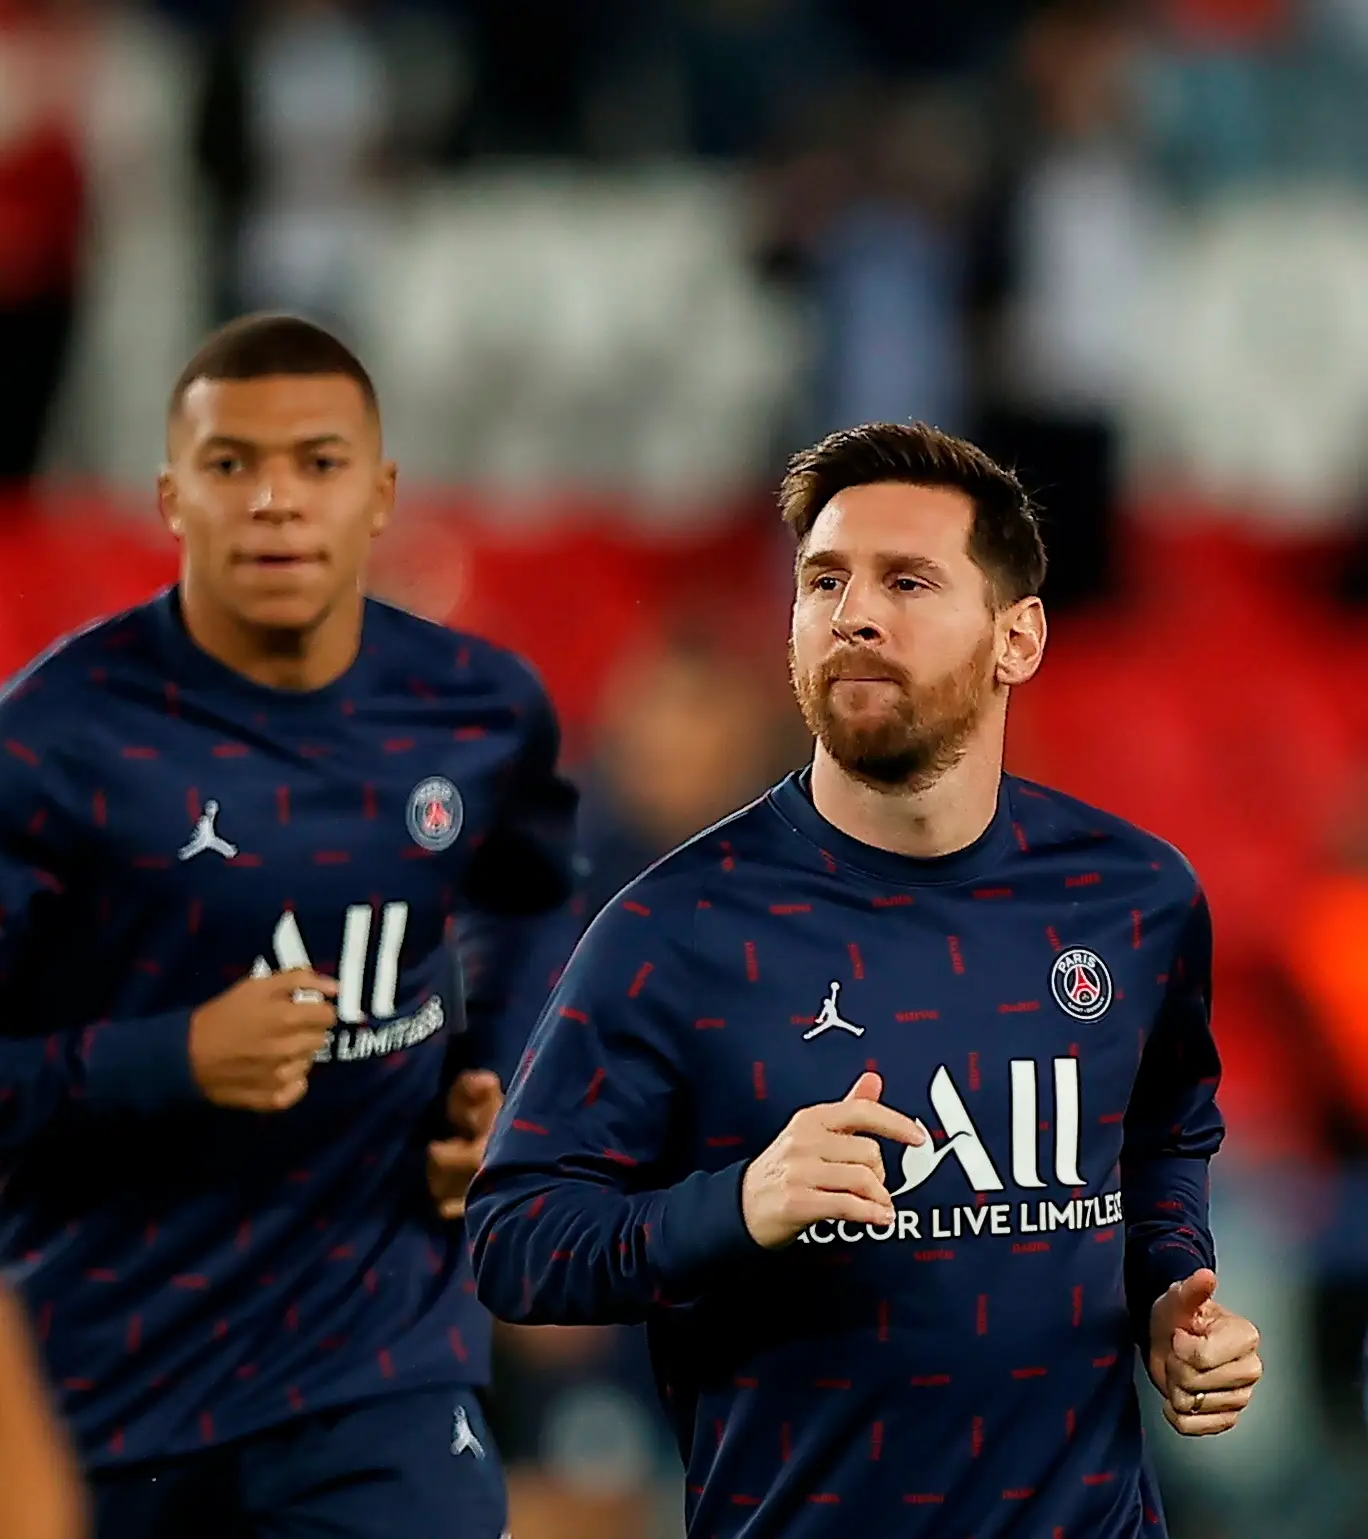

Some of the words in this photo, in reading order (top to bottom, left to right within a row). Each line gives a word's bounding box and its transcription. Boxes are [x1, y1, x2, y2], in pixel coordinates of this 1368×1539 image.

[1057, 953, 1096, 974] PARIS
[796, 1210, 922, 1243] CCOR
[932, 1204, 1011, 1238] LIVE
